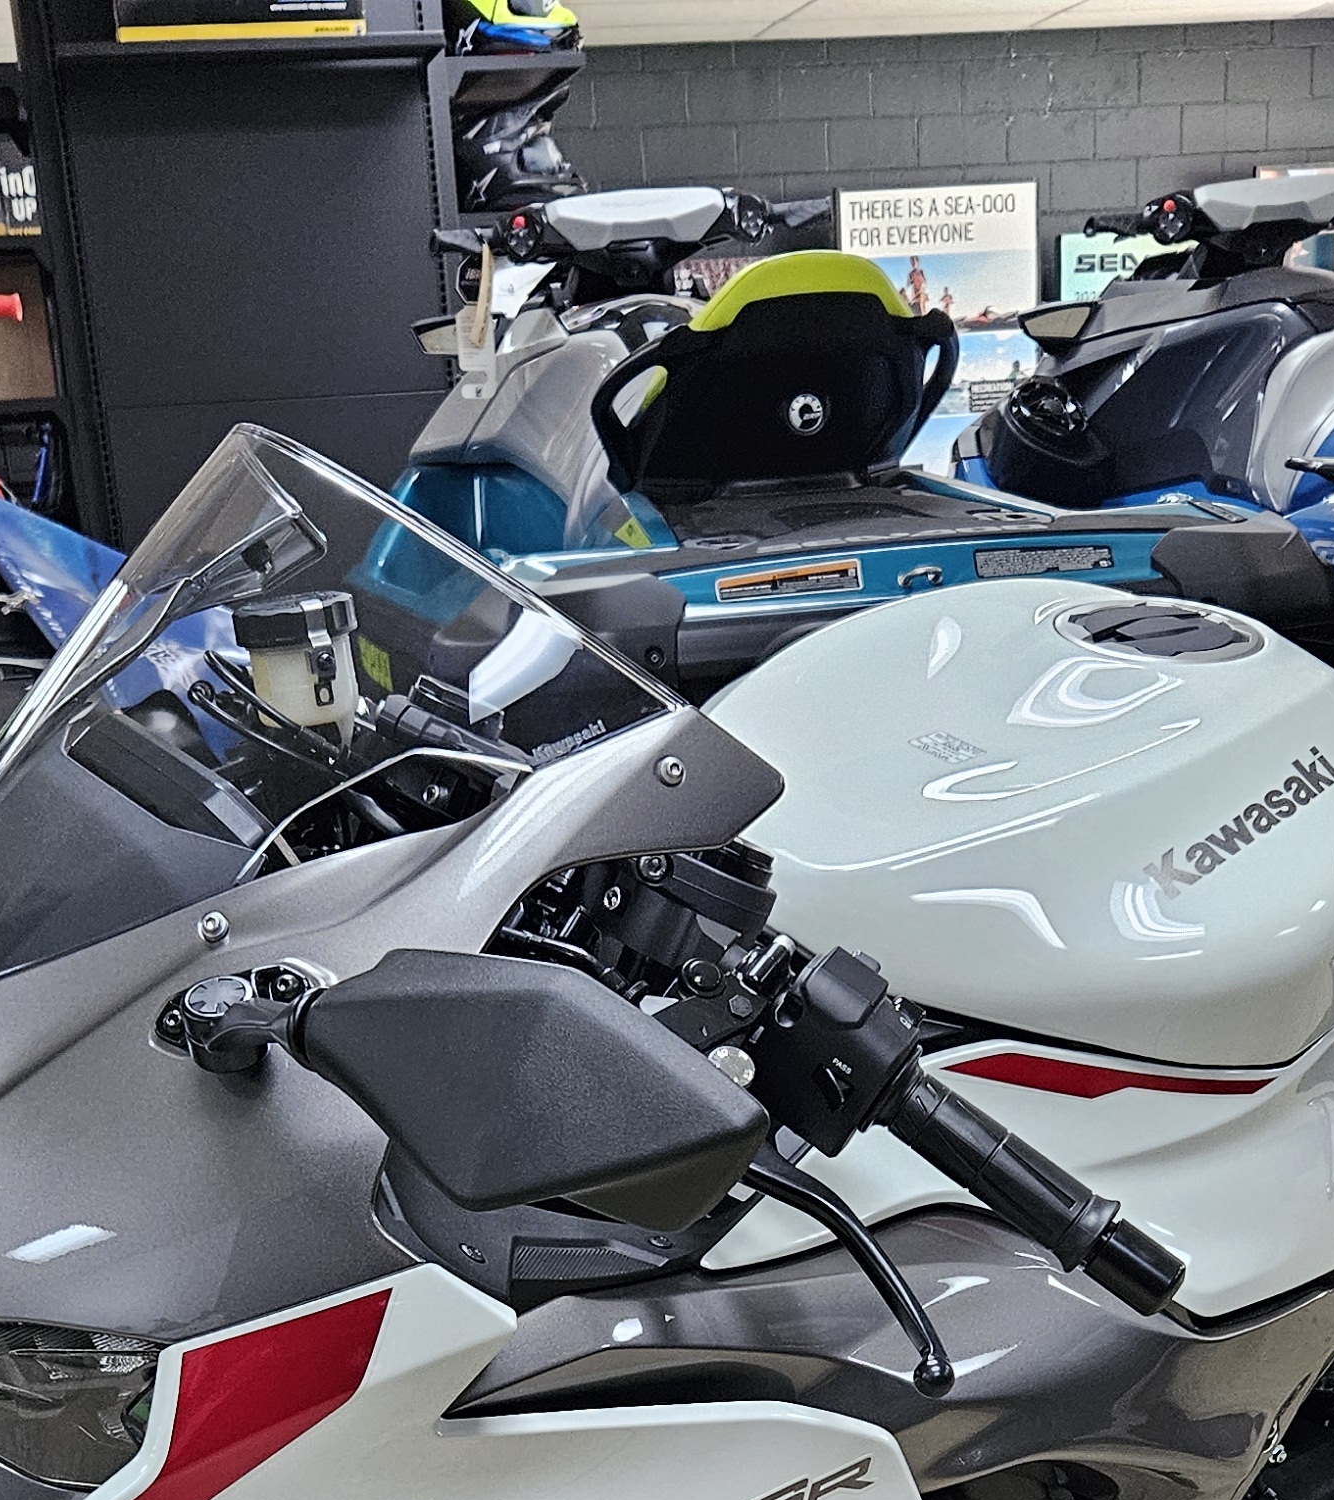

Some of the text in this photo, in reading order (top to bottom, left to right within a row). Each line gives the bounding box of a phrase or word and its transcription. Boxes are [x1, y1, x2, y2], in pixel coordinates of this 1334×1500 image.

[849, 193, 1016, 221] THERE IS A SEA-DOO
[849, 222, 974, 247] FOR EVERYONE
[832, 1057, 853, 1075] PASS
